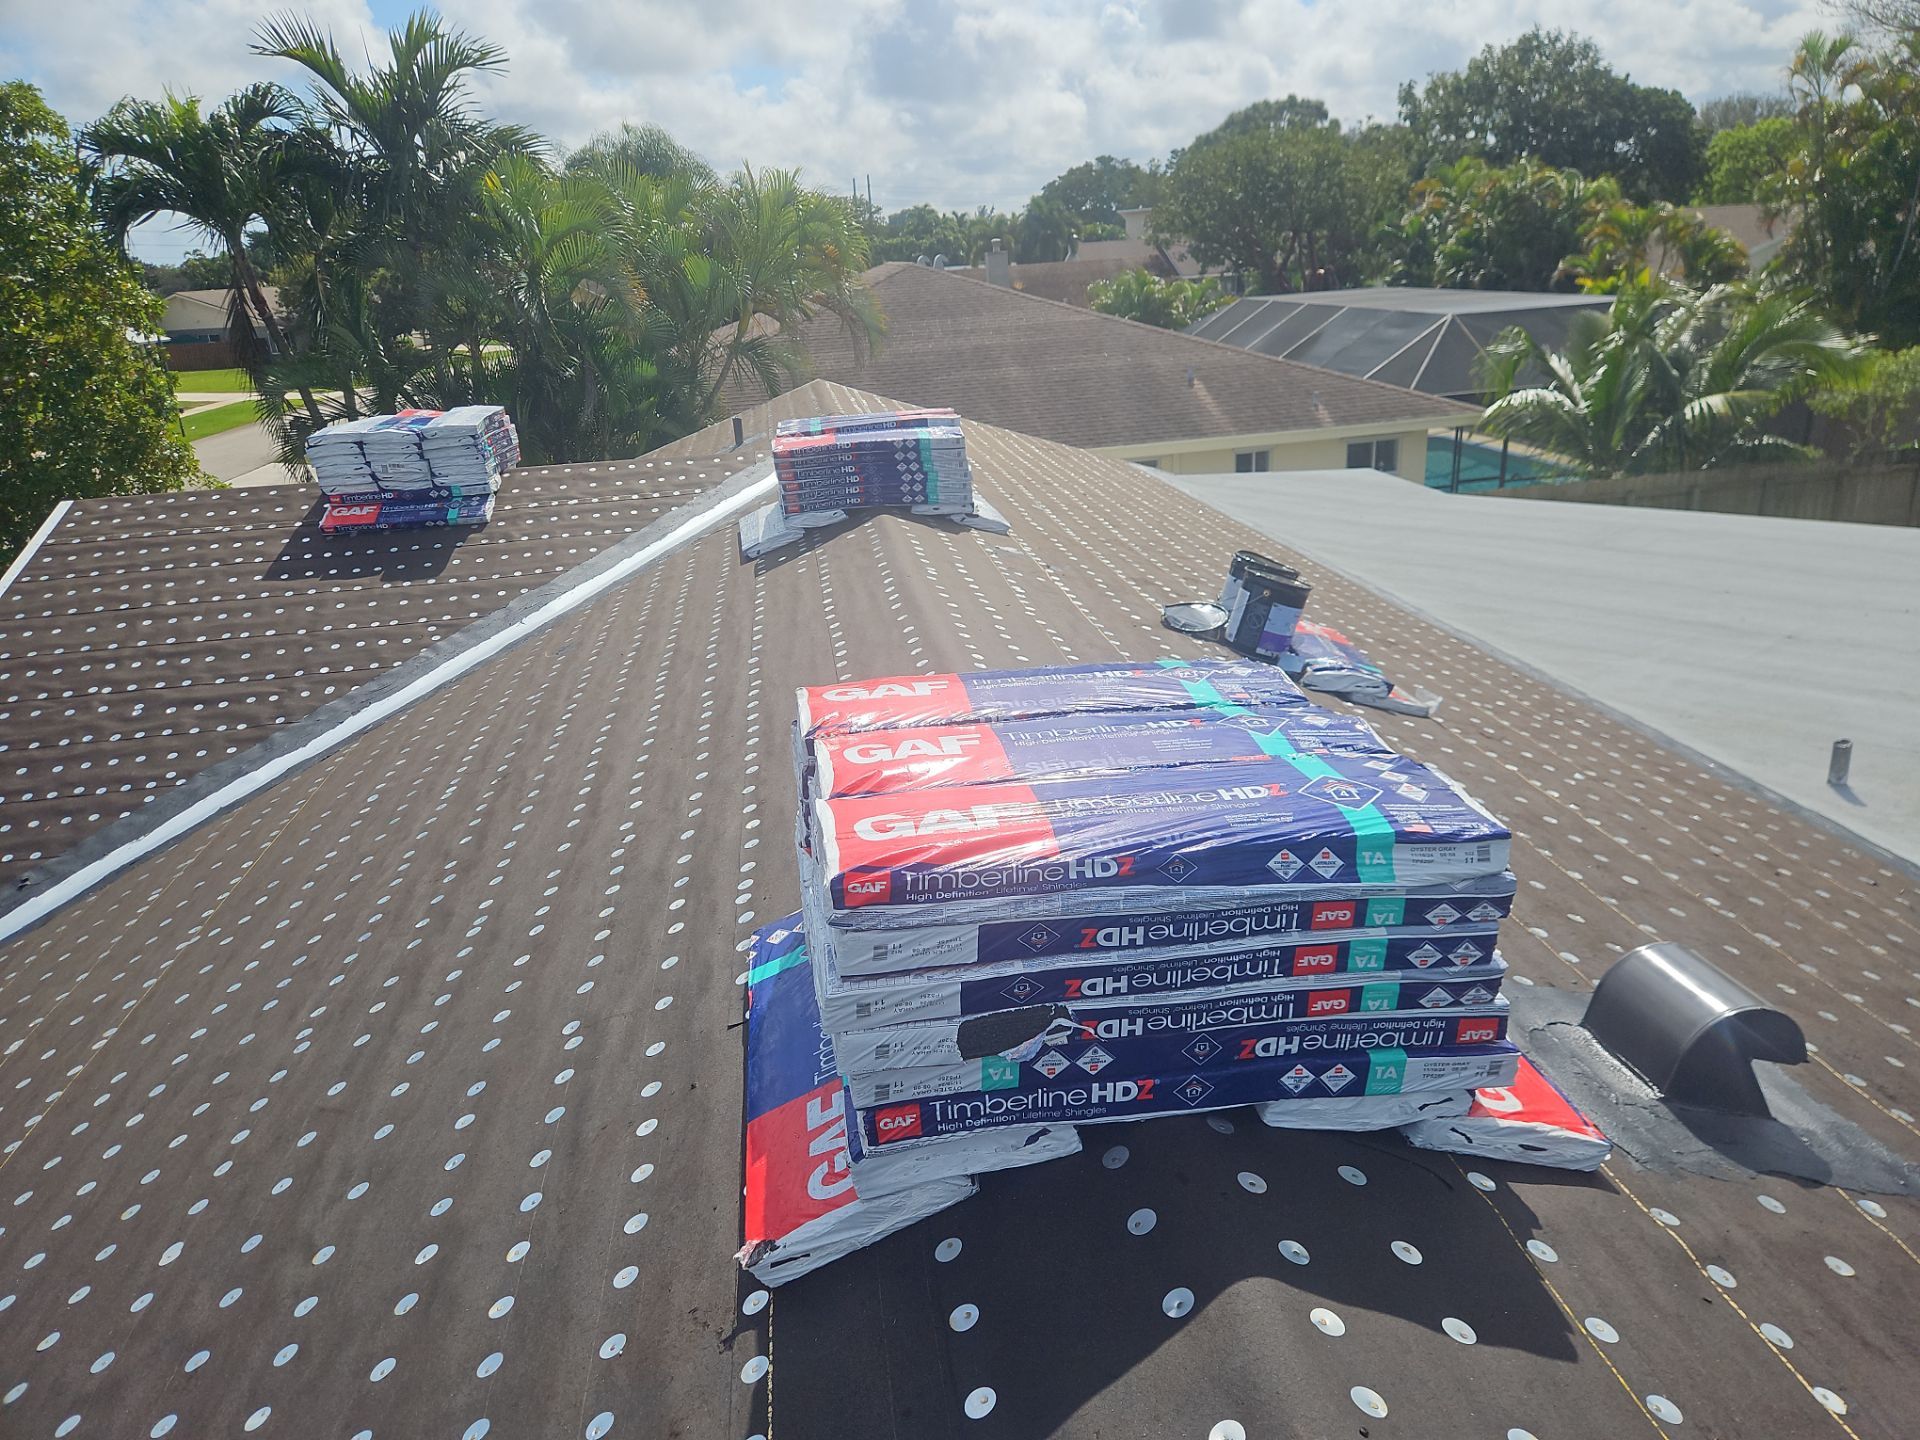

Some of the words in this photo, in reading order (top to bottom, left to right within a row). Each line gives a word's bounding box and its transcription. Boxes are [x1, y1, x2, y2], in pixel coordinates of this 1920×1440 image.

[332, 506, 377, 516] GAF
[821, 680, 949, 702] GAF
[1002, 722, 1148, 741] Timberline
[843, 734, 981, 764] GAF
[1217, 784, 1288, 801] HDZ
[854, 802, 1022, 842] GAF
[1362, 852, 1387, 864] TA
[901, 865, 1064, 892] Timberline
[1068, 856, 1135, 880] HDZ
[848, 881, 887, 894] GAF
[906, 892, 932, 902] High
[936, 890, 988, 900] Definition
[1042, 882, 1088, 891] Shingles
[1222, 905, 1271, 916] Definition
[1274, 904, 1299, 912] High
[1128, 914, 1172, 923] Shingles
[1178, 912, 1215, 920] Lifetime
[1316, 910, 1352, 922] GAF
[1372, 912, 1396, 925] TA
[1149, 912, 1302, 940] Timberline
[1080, 926, 1144, 948] HDZ
[1204, 953, 1253, 964] Definition
[1256, 950, 1280, 958] High
[1298, 954, 1334, 967] GAF
[1354, 954, 1378, 968] TA
[1112, 964, 1155, 973] Shingles
[1132, 958, 1284, 988] Timberline
[1064, 975, 1128, 998] HDZ
[1219, 996, 1268, 1008] Definition
[1270, 994, 1294, 1002] High
[1128, 1007, 1170, 1016] Shingles
[1312, 999, 1346, 1011] GAF
[1368, 999, 1391, 1011] TA
[1147, 1003, 1294, 1031] Timberline
[1081, 1018, 1144, 1040] HDZ
[1286, 1023, 1327, 1032] Shingles
[1330, 1022, 1367, 1030] Lifetime
[1373, 1021, 1420, 1031] Definition
[1422, 1020, 1446, 1029] High
[1302, 1028, 1444, 1050] Timberline
[1460, 1030, 1495, 1041] GAF
[1238, 1036, 1300, 1059] HDZ
[988, 1068, 1014, 1081] TA
[1376, 1066, 1398, 1080] TA
[929, 1088, 1088, 1122] Timberline
[1091, 1079, 1154, 1104] HDZ
[879, 1114, 918, 1130] GAF
[938, 1121, 962, 1132] High
[966, 1114, 1016, 1128] Definition
[1022, 1110, 1060, 1120] Lifetime
[1065, 1106, 1107, 1116] Shingles
[806, 1090, 854, 1200] GAF
